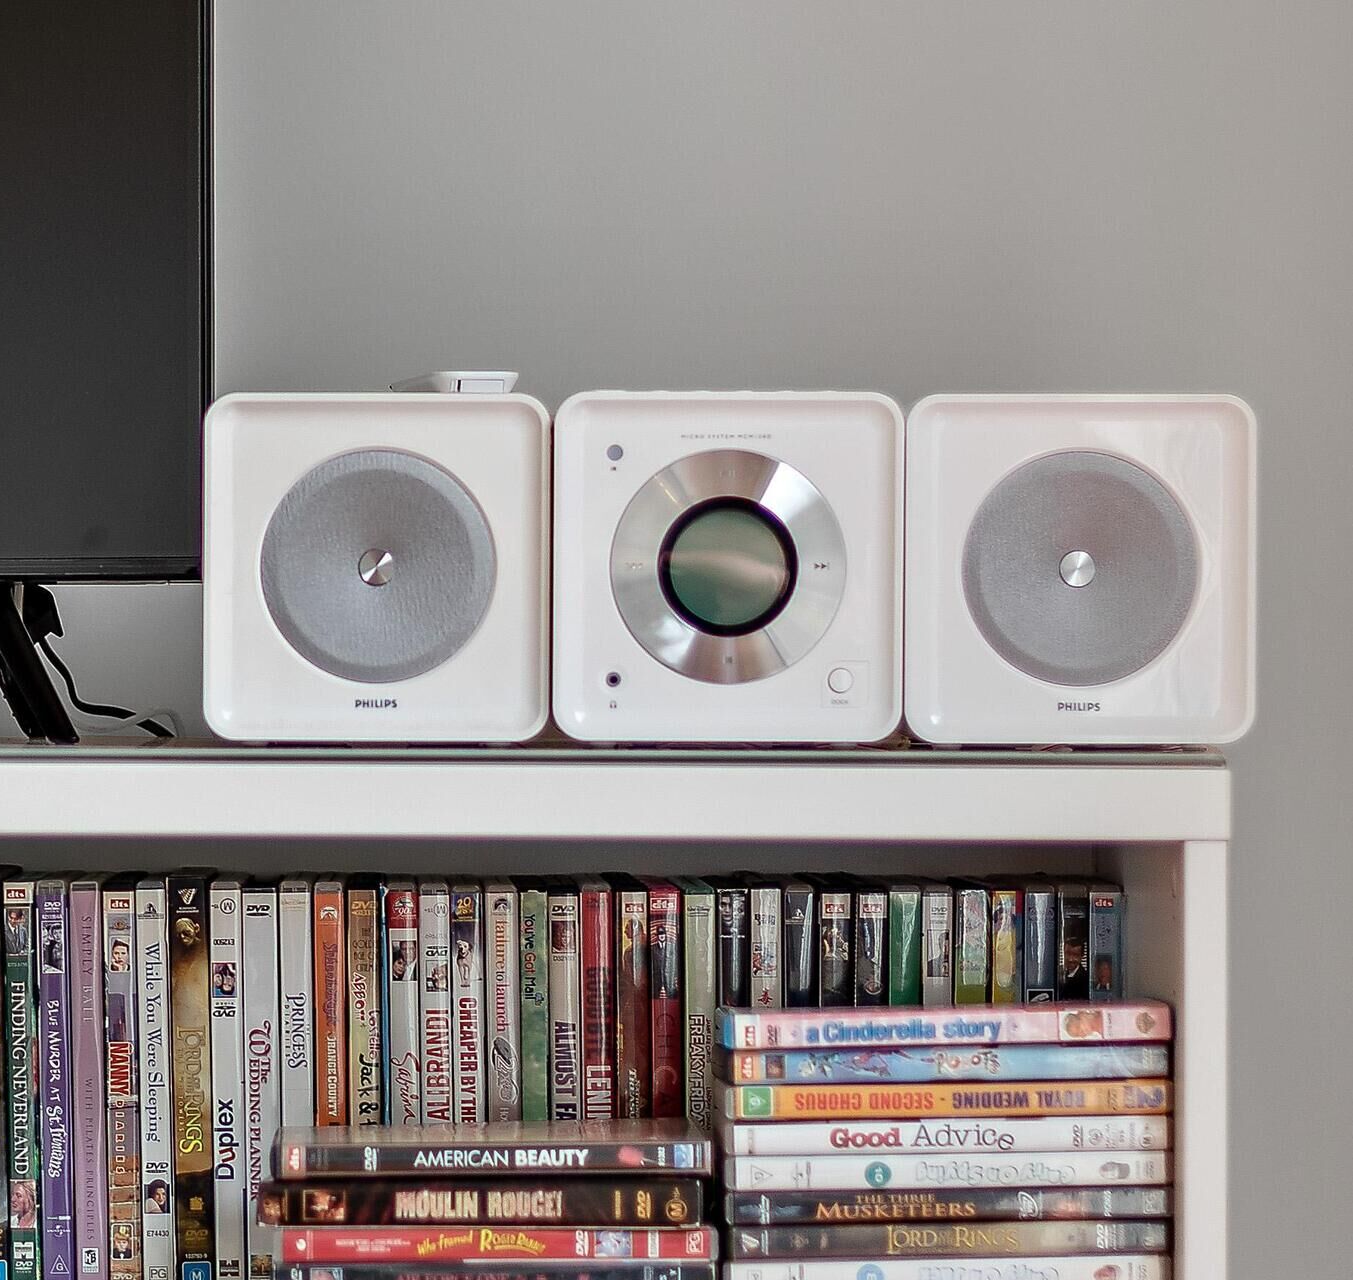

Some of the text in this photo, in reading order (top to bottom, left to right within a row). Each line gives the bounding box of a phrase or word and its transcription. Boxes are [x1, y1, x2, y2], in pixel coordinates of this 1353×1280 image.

[354, 698, 399, 709] PHILIPS
[1057, 701, 1102, 713] PHILIPS
[495, 920, 508, 969] failure
[524, 914, 537, 1000] You've Got Mail
[495, 971, 506, 981] to
[47, 1000, 59, 1026] BLUE
[496, 984, 508, 1032] launch
[145, 943, 167, 1143] While You Were Sleeping
[286, 992, 308, 1069] PRINCESS
[806, 1018, 1002, 1043] a Cinderella story
[47, 1031, 62, 1082] MURDER
[260, 1057, 271, 1084] The
[425, 1010, 450, 1121] ALIBRANDI
[459, 997, 478, 1123] CHEAPER BY THE
[11, 982, 29, 1174] FINDING NEVERLAND
[391, 1052, 419, 1125] Sabrina
[50, 1086, 60, 1101] AT
[109, 1042, 132, 1174] NANNY DIARIES
[794, 1092, 864, 1110] CHORUS
[869, 1092, 934, 1110] SECOND
[952, 1090, 1030, 1109] WEDDING
[248, 1020, 272, 1201] WEDDING PLANNER
[214, 1099, 239, 1180] Duplex
[830, 1123, 1016, 1152] Good Advice
[414, 1148, 590, 1168] AMERICAN BEAUTY
[395, 1190, 478, 1219] MOULIN
[815, 1202, 976, 1220] MUSKETEERS
[855, 1193, 936, 1204] THE THREE
